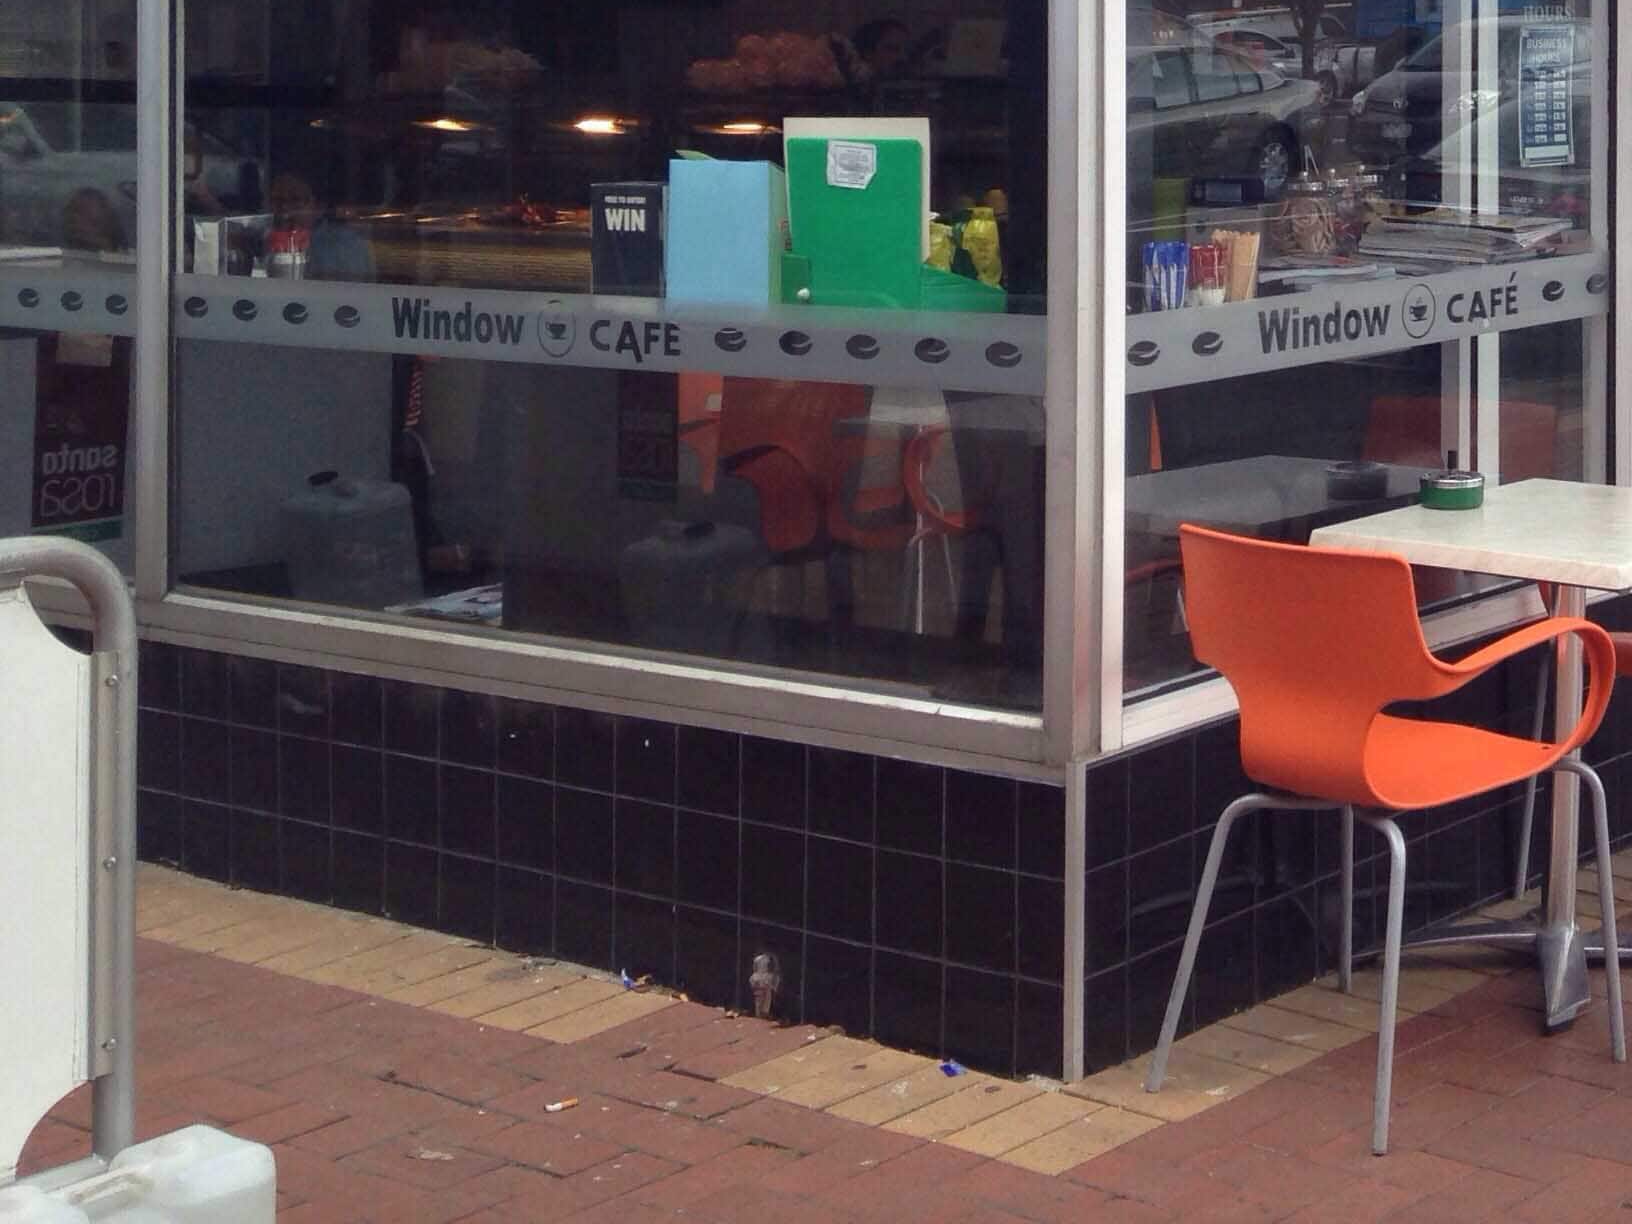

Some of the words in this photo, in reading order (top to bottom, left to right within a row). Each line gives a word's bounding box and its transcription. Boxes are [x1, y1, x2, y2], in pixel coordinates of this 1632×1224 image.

[604, 207, 646, 232] WIN
[391, 296, 525, 346] Window
[1257, 300, 1392, 355] Window
[1446, 271, 1519, 324] CAFÉ
